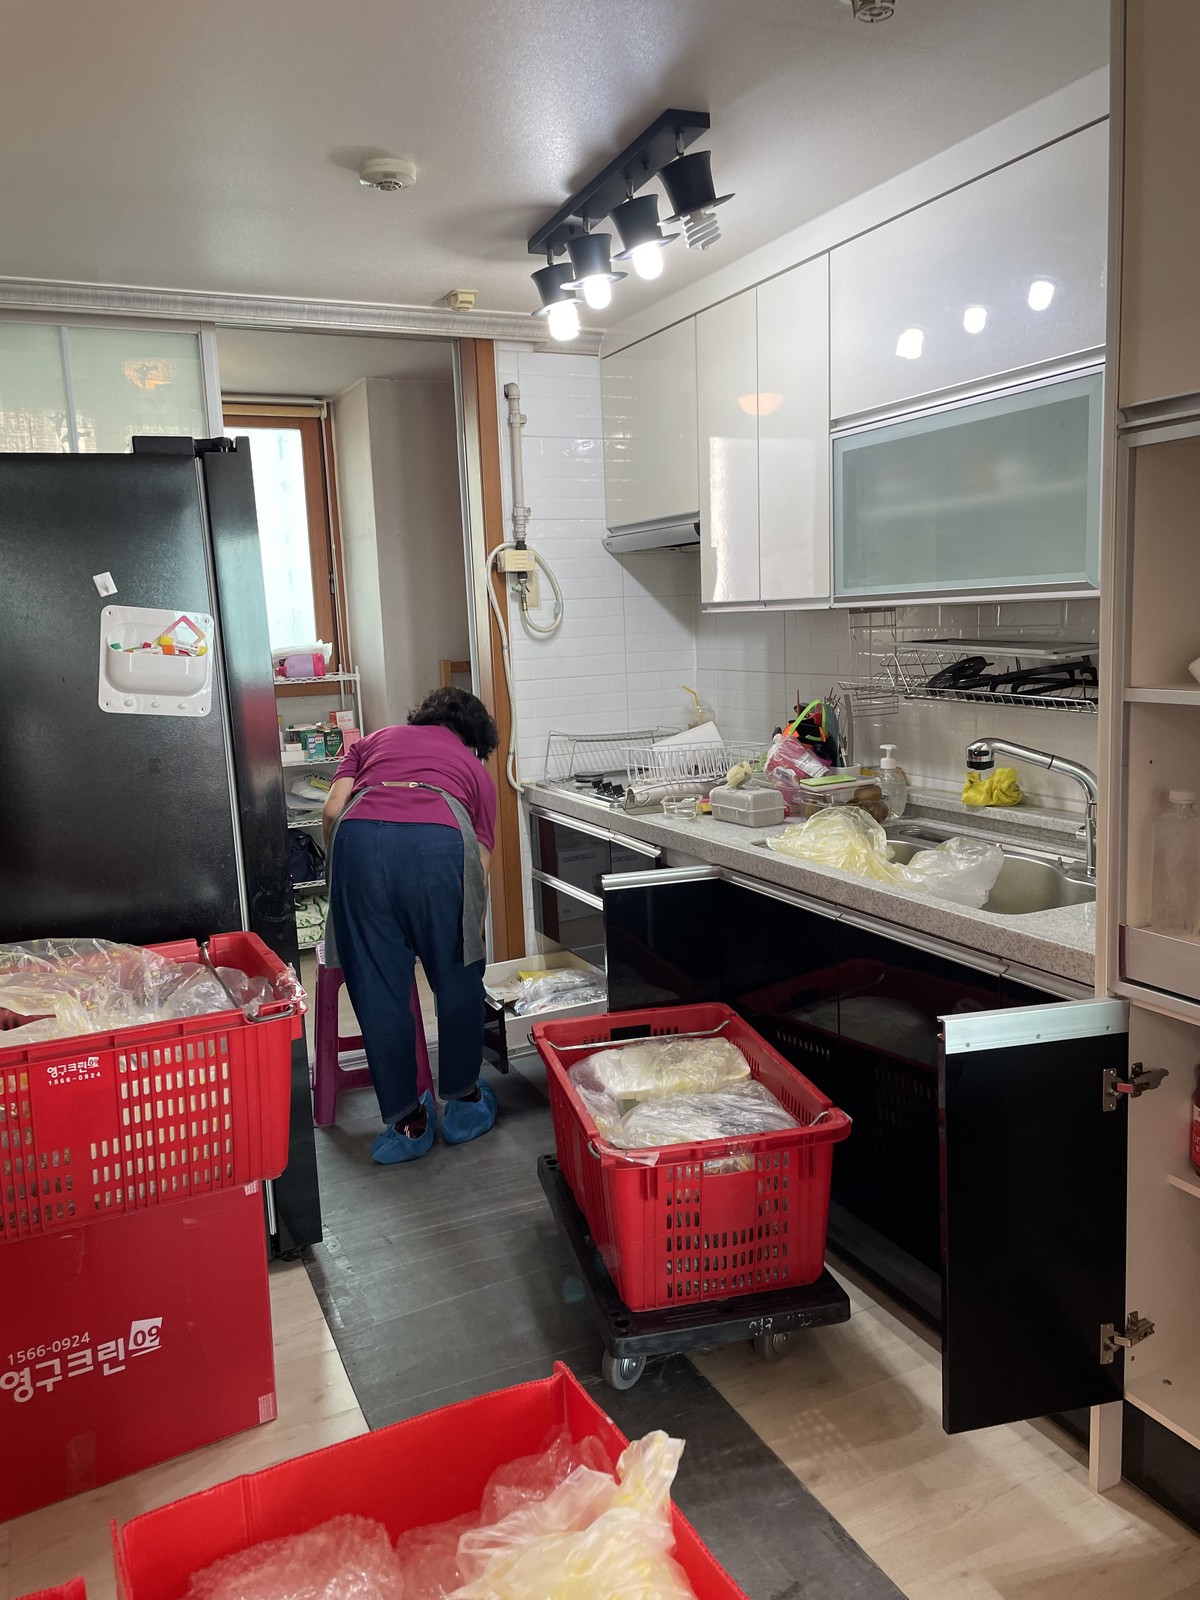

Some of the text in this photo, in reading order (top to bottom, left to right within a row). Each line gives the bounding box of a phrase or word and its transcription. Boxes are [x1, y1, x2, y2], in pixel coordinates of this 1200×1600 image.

[47, 1061, 88, 1078] 영구크린
[48, 1071, 101, 1086] 1566-0924
[7, 1331, 91, 1366] 1566-0924
[0, 1337, 126, 1403] 영구크린
